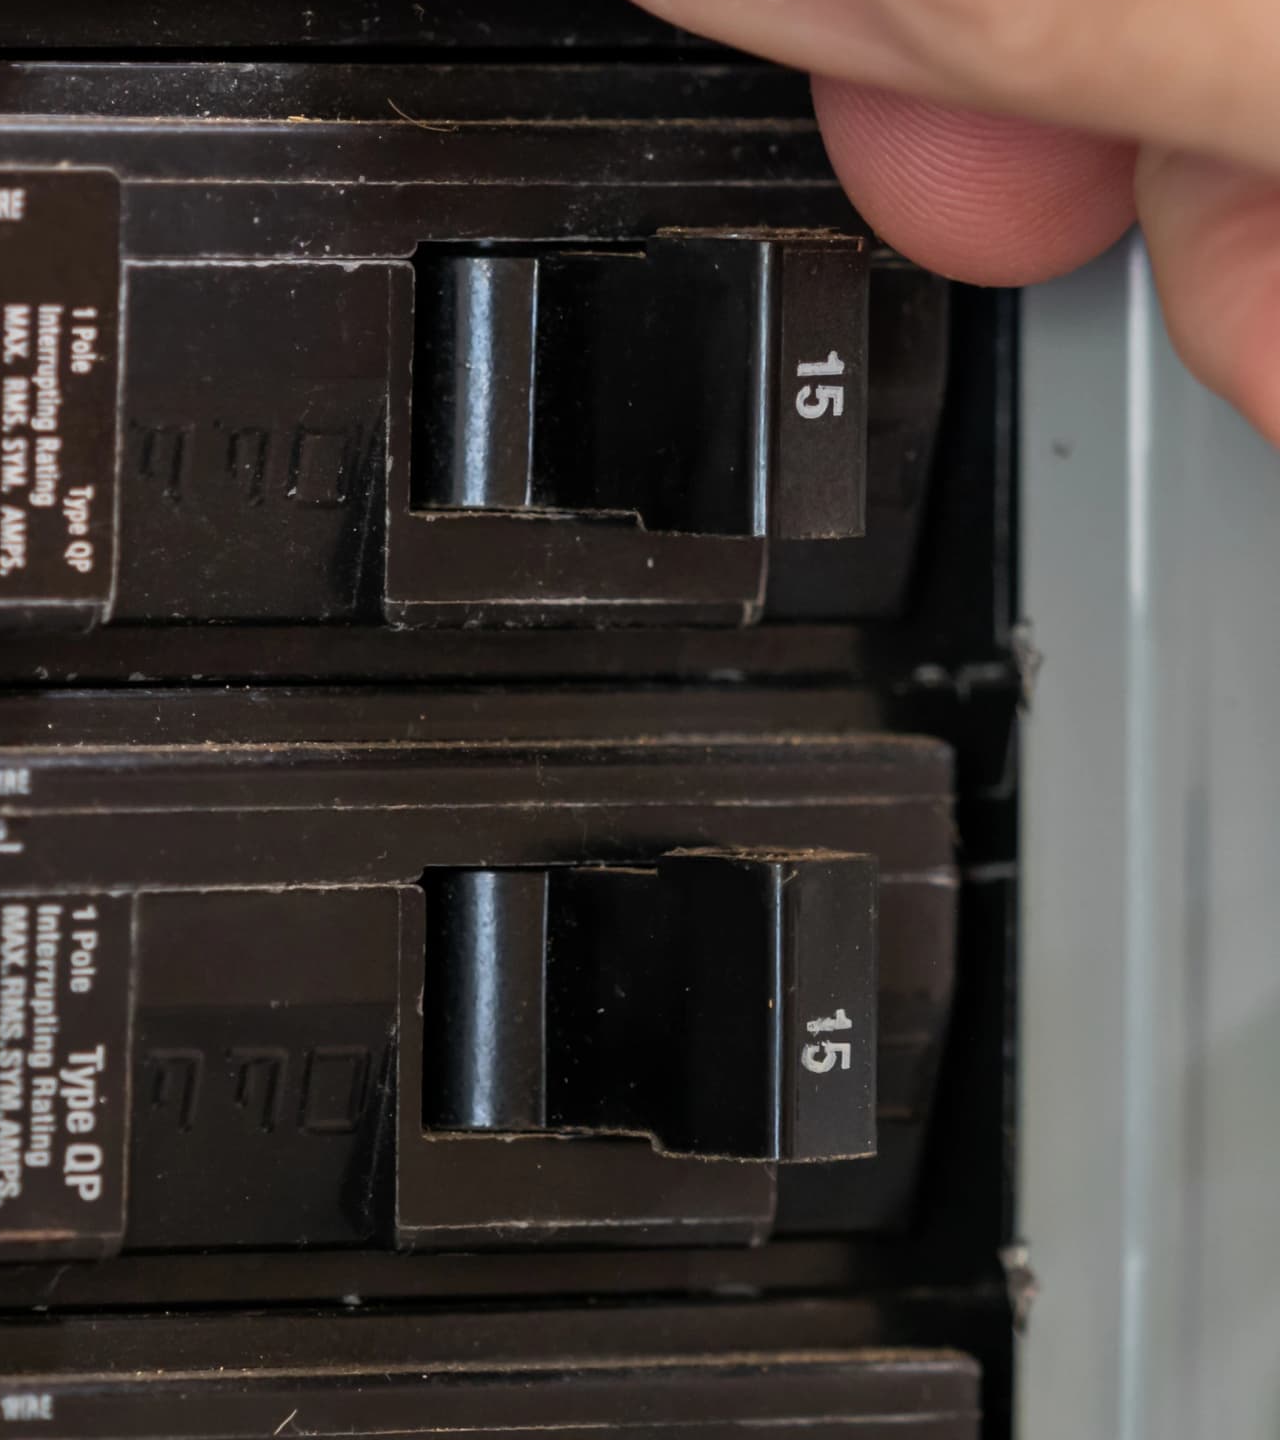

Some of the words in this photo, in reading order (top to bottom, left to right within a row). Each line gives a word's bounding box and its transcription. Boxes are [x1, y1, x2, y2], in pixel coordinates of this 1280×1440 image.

[4, 305, 29, 363] MAX.
[72, 308, 97, 318] 1
[30, 305, 63, 431] Interrupting
[71, 327, 97, 373] Pole
[2, 378, 29, 432] RMS.
[796, 350, 844, 419] 15
[1, 438, 27, 492] SYM.
[29, 437, 61, 506] Rating
[63, 486, 94, 535] Type
[0, 506, 26, 576] AMPS.
[64, 541, 92, 572] QP
[72, 906, 97, 919] 1
[26, 905, 63, 1070] Interrupting
[70, 931, 98, 992] Pole
[801, 1009, 852, 1073] 15
[60, 1045, 105, 1133] Type
[24, 1077, 58, 1167] Rating
[64, 1144, 102, 1200] QP
